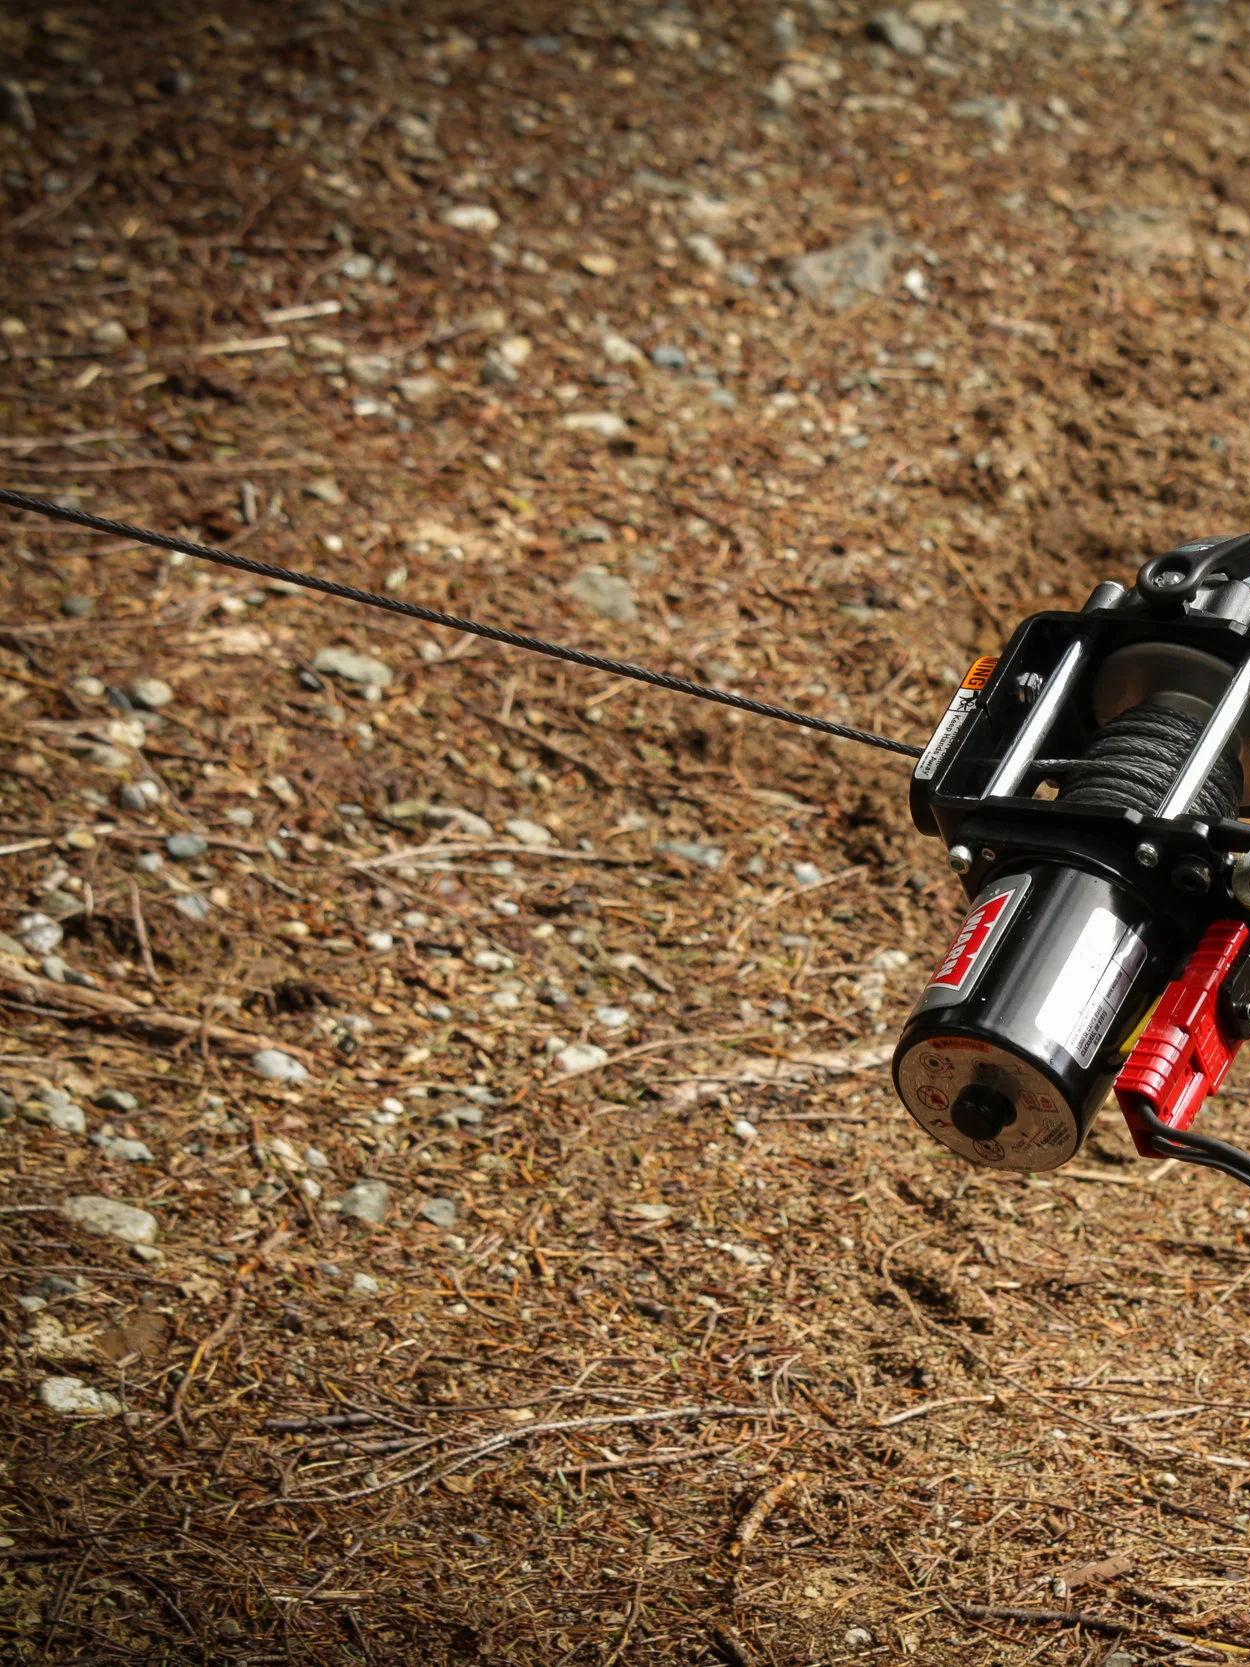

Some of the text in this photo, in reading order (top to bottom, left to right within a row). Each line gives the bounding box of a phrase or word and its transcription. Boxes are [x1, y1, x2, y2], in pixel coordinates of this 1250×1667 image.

[945, 714, 961, 732] Keep
[932, 733, 951, 755] Hands
[922, 756, 937, 775] Away
[936, 911, 986, 979] WARN
